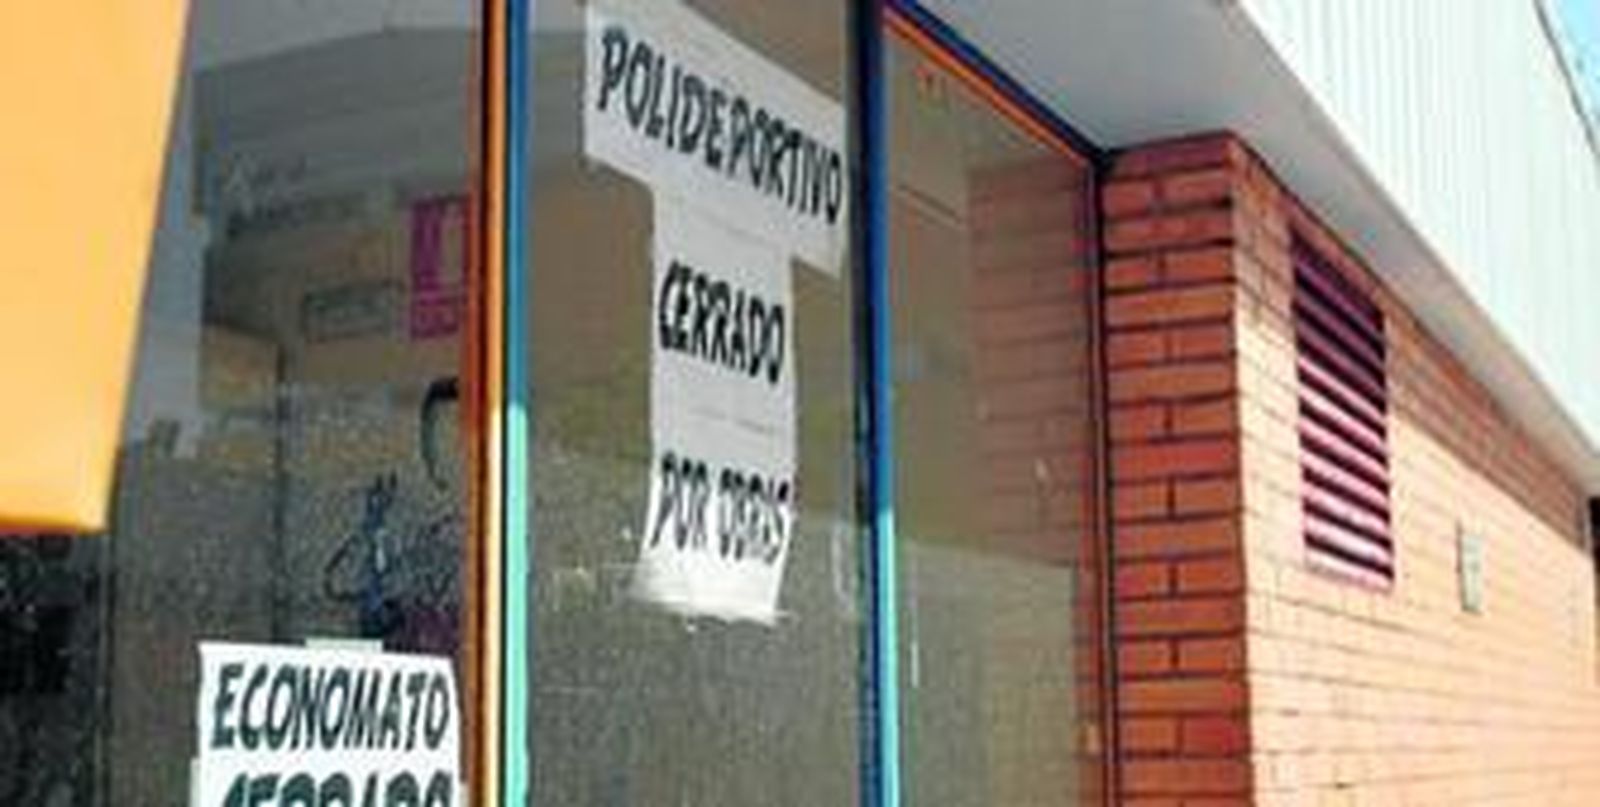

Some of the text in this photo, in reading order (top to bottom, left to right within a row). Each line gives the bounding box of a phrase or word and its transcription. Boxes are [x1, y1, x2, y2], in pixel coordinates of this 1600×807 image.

[596, 26, 842, 226] POLIDEPORTIVO
[659, 260, 785, 385] CERRADO
[650, 450, 789, 565] POR OBRAS
[211, 663, 450, 750] ECONOMATO
